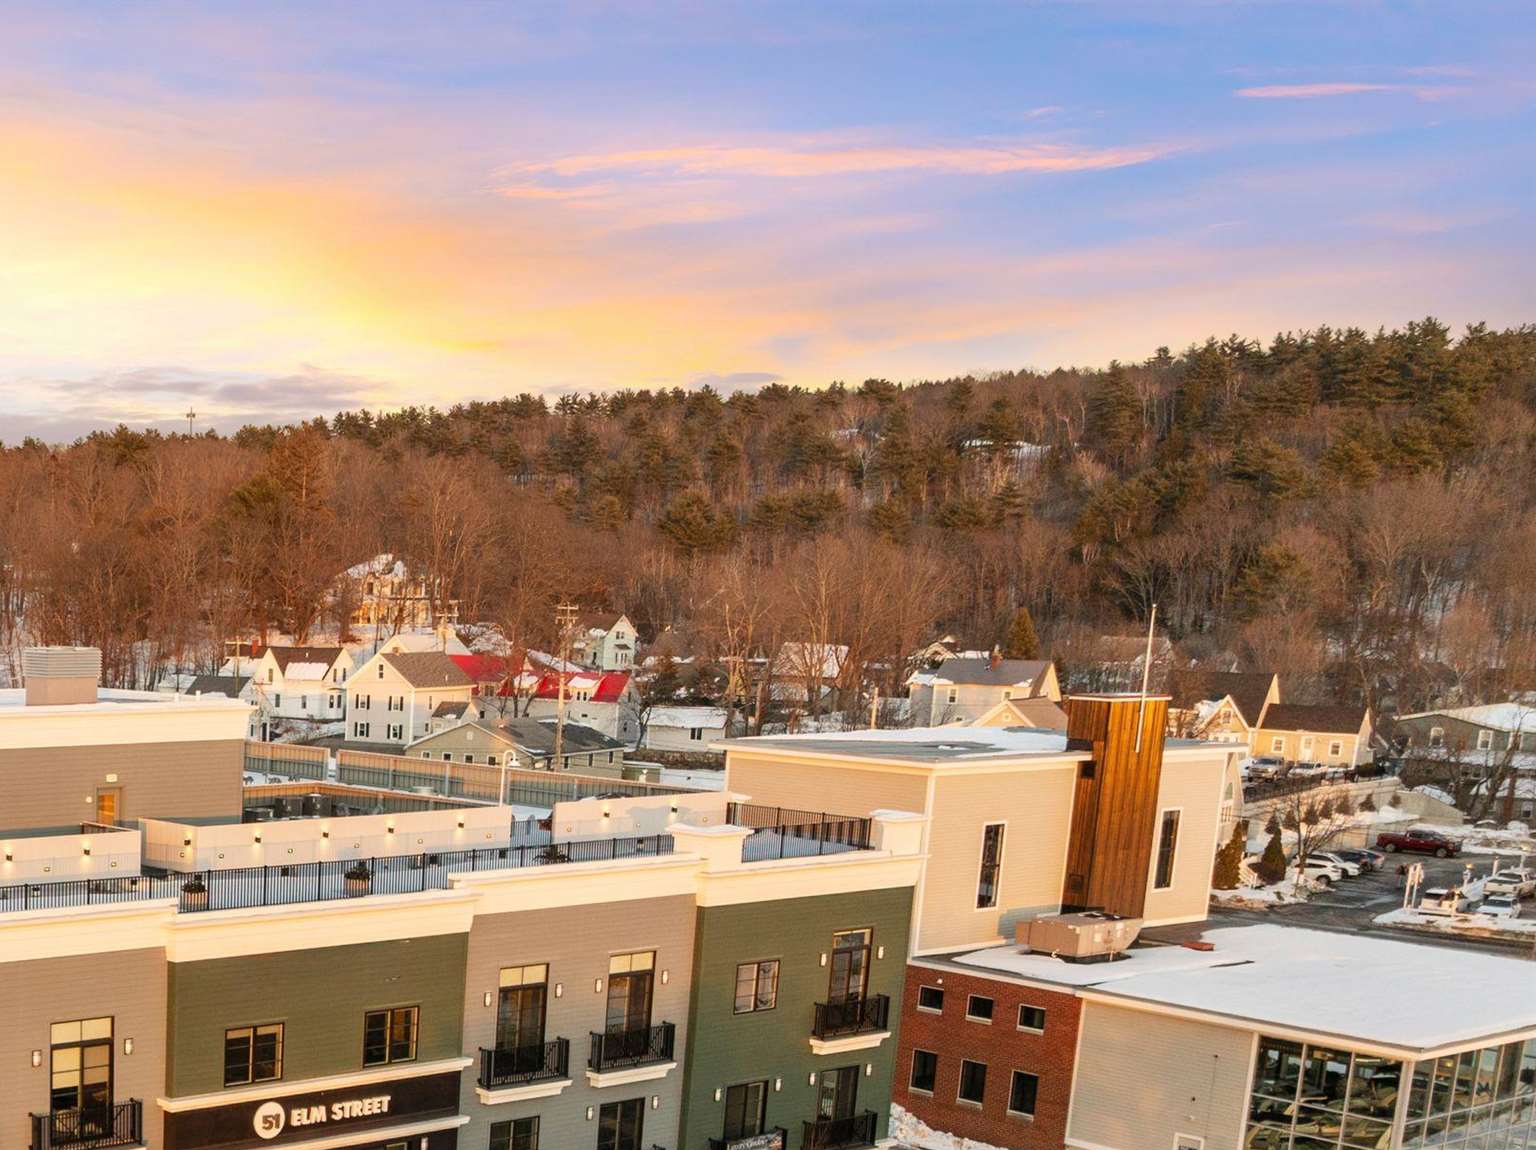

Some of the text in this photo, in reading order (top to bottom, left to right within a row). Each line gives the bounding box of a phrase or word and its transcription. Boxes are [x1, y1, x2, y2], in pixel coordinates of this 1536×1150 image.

[261, 1096, 392, 1131] 51 ELM STREET
